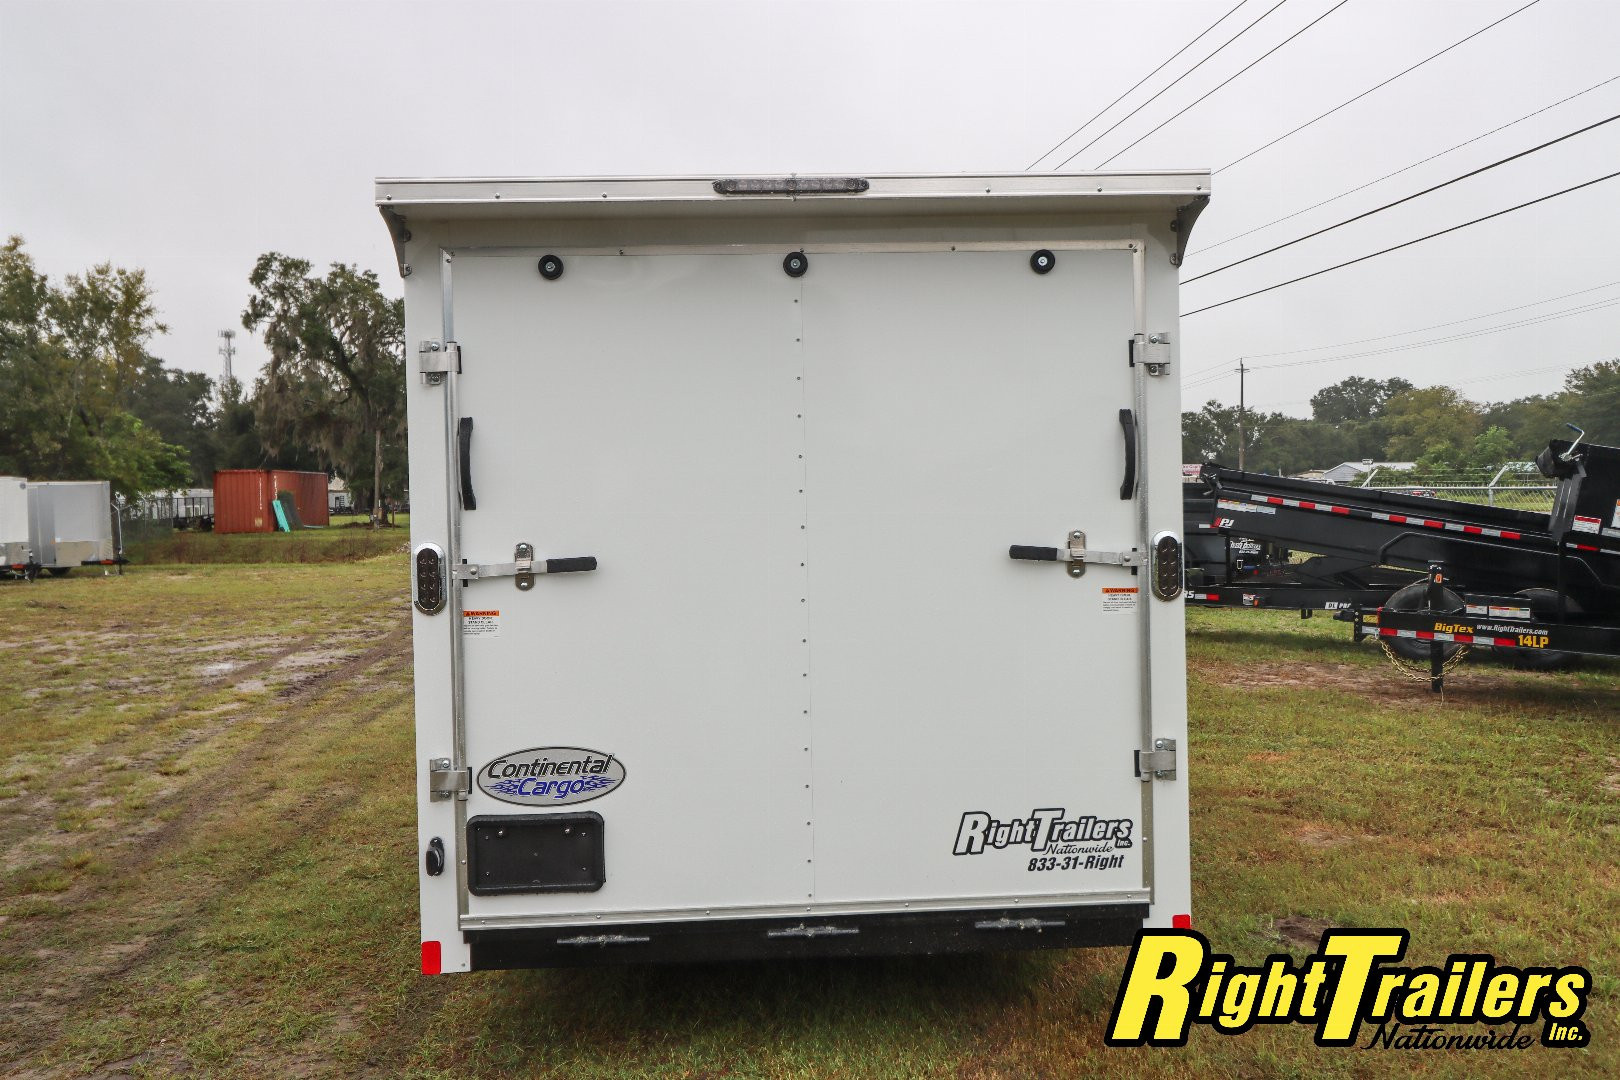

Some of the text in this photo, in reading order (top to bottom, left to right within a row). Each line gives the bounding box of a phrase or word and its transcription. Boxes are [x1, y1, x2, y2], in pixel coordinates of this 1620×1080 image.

[1219, 518, 1235, 527] PJ
[1434, 622, 1474, 634] BigTex
[1476, 624, 1549, 635] www.RightTrailers.com
[1518, 635, 1549, 648] 14LP
[487, 754, 614, 779] Continental
[517, 777, 586, 799] Cargo
[1043, 841, 1115, 855] Nationwide
[1027, 854, 1125, 872] 833-31-Right
